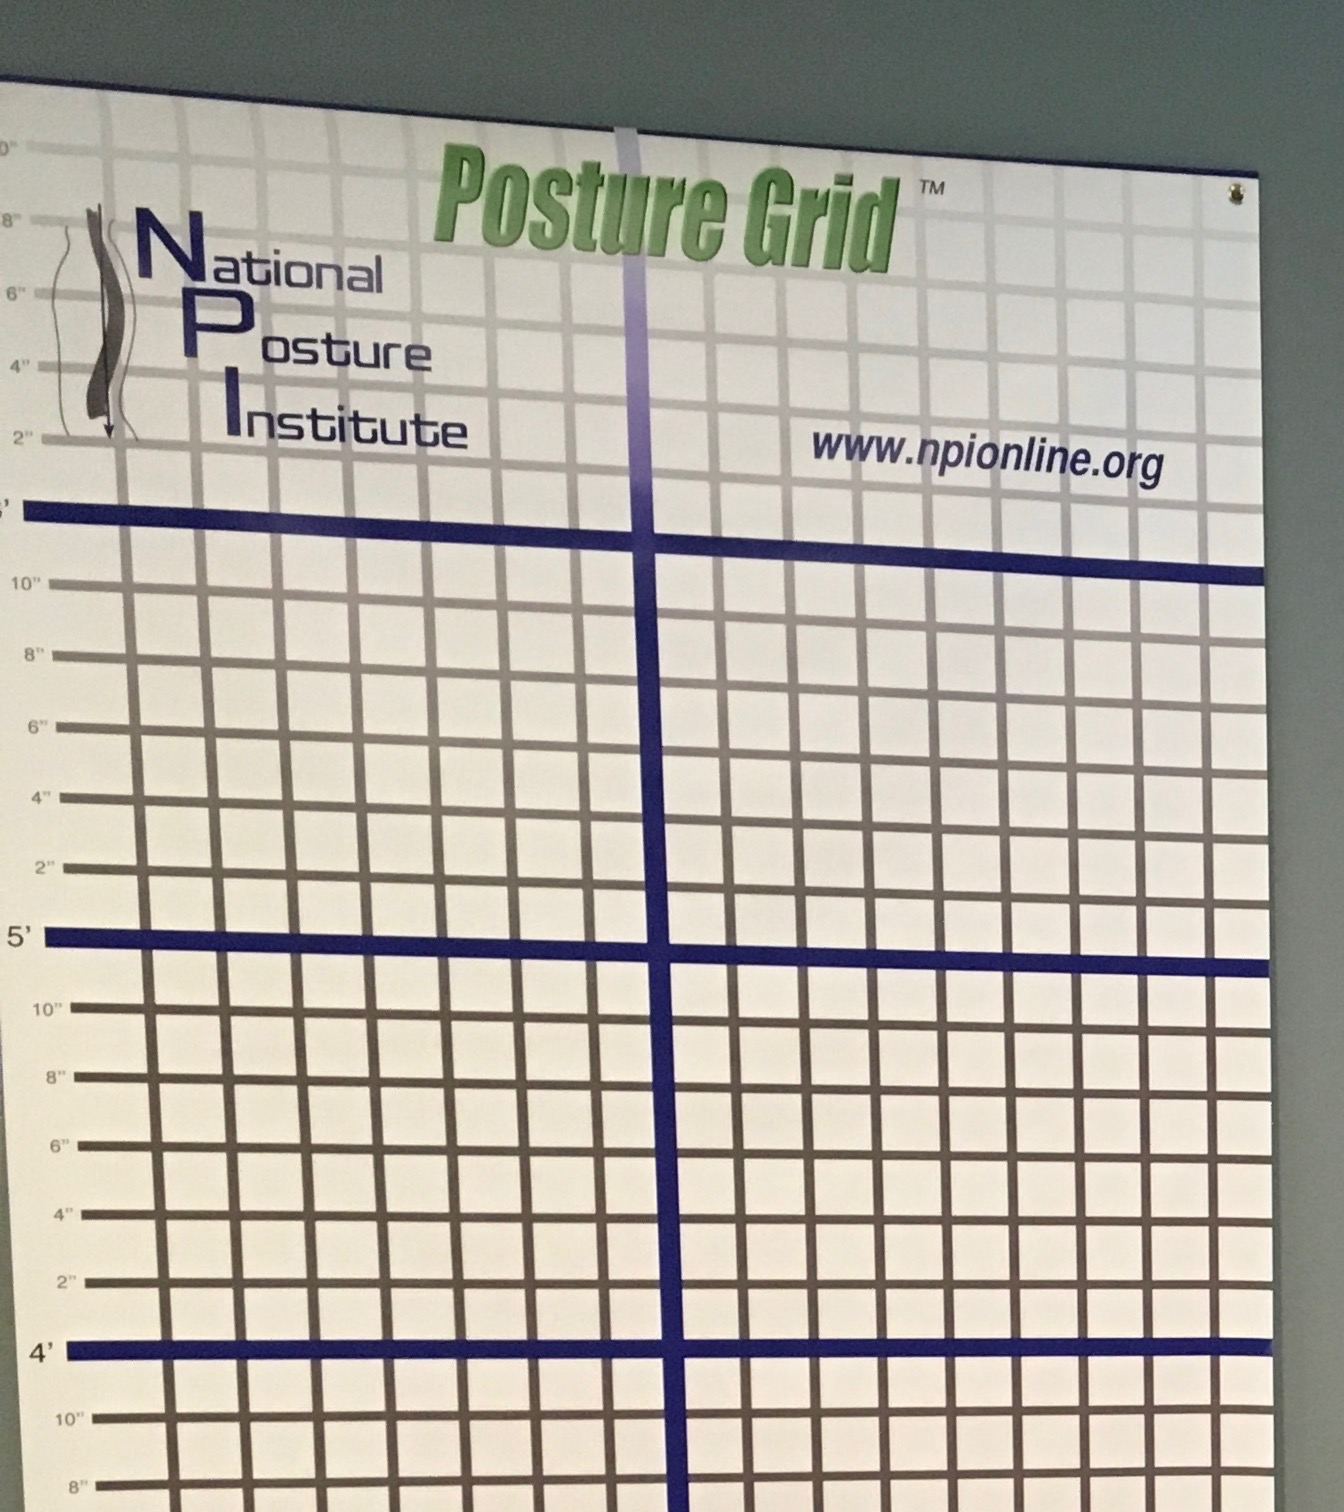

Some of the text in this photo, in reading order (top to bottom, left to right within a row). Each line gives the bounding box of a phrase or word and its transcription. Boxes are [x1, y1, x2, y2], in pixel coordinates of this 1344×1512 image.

[134, 206, 383, 294] National
[432, 142, 901, 274] Posture Grid
[180, 286, 434, 373] Posture
[224, 366, 469, 450] Institute
[811, 428, 1165, 490] www.npionline.org
